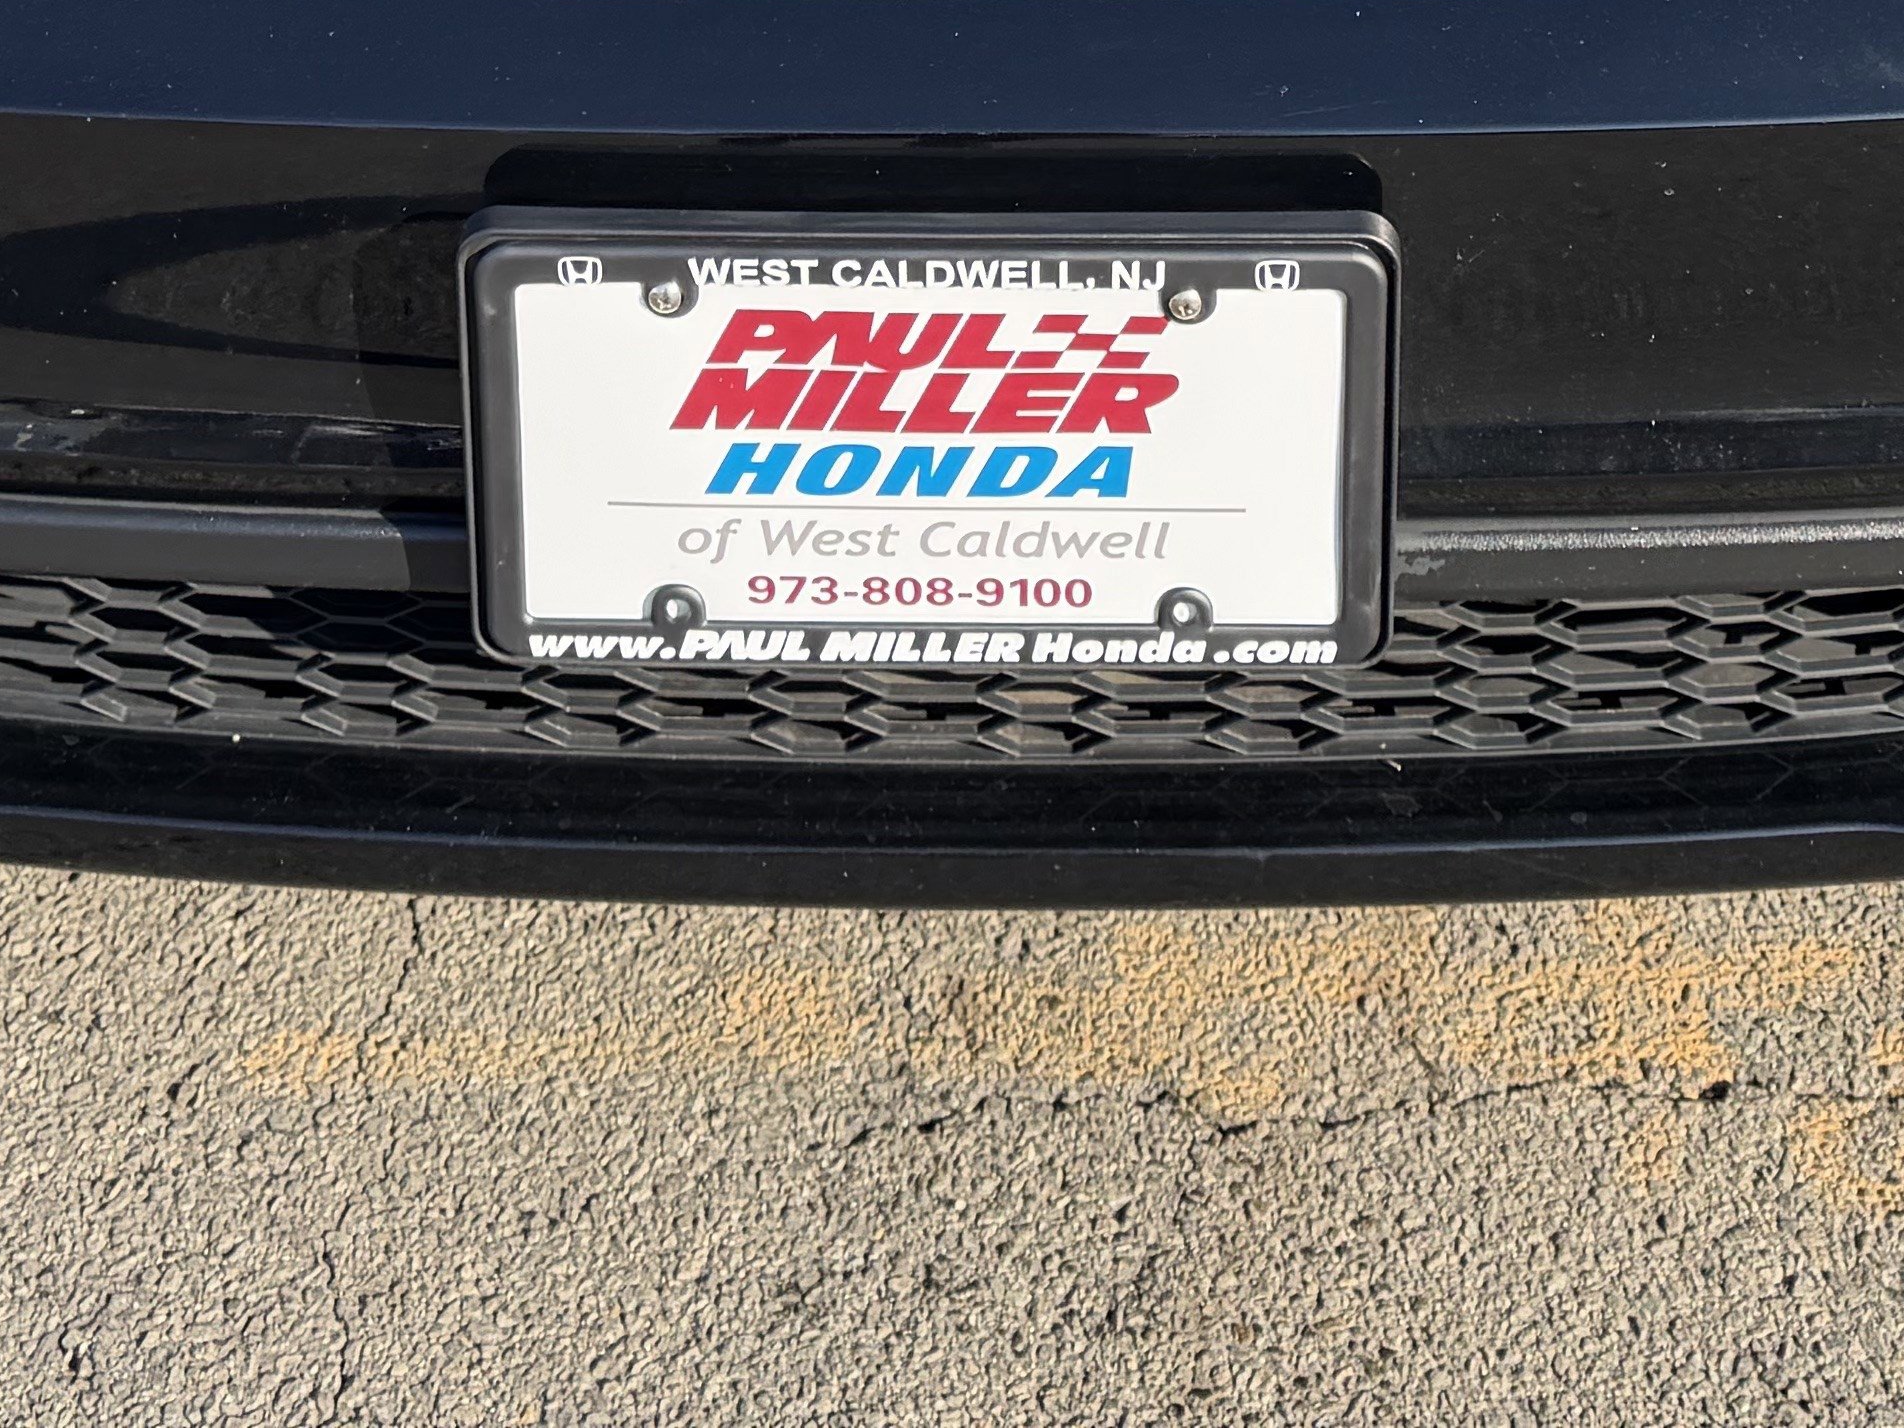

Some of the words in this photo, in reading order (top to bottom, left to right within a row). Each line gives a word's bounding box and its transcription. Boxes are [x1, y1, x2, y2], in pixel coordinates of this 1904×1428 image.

[687, 257, 819, 288] WEST
[831, 258, 1096, 291] CALDWELL,
[1110, 259, 1166, 292] NJ
[705, 308, 1016, 372] PAUL
[668, 367, 1180, 434] MILLER
[704, 442, 1134, 498] HONDA
[677, 517, 743, 565] of
[759, 519, 900, 557] West
[919, 520, 1171, 560] Caldwell
[746, 575, 1094, 609] 973-808-9100
[528, 628, 811, 661] www.PAUL
[818, 630, 1026, 663] MILLER
[1031, 631, 1206, 664] Honda
